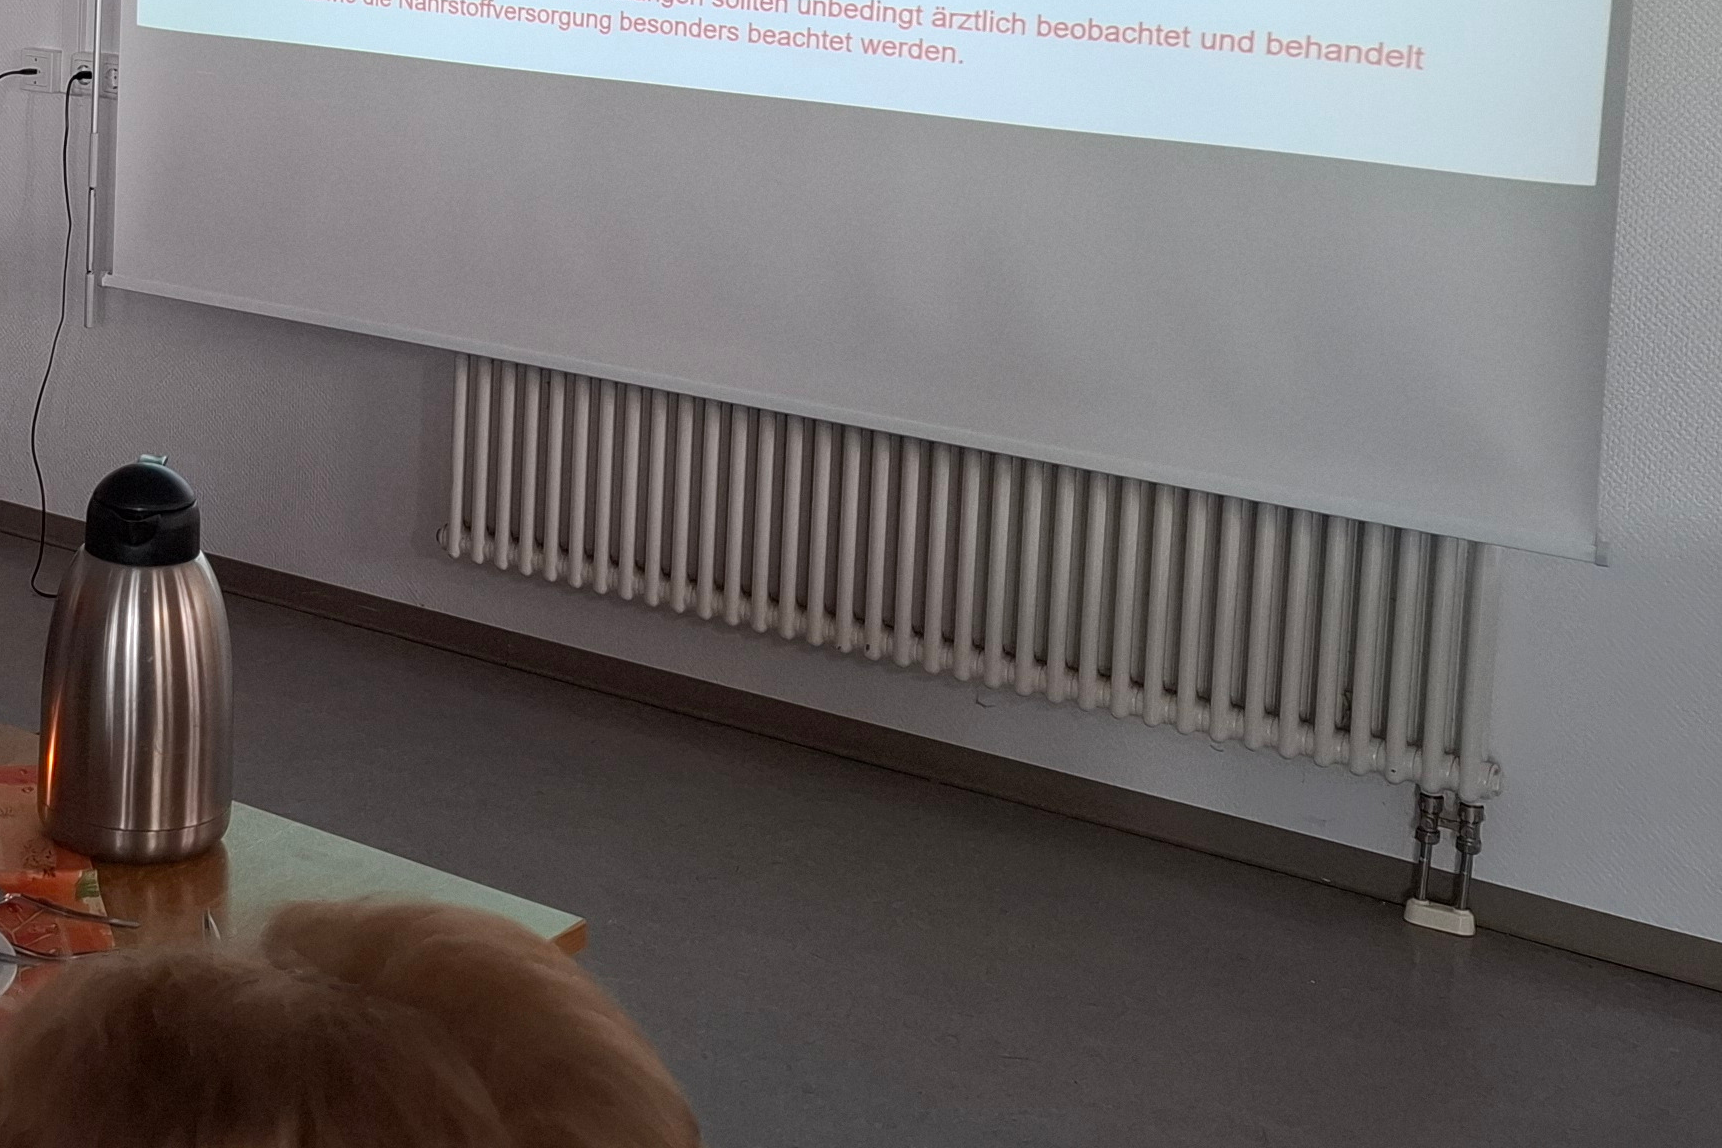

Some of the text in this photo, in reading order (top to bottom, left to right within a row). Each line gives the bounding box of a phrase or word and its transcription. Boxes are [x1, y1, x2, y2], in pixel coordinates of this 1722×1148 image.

[619, 11, 740, 42] besonders
[747, 23, 853, 53] beachtet
[860, 35, 964, 64] werden.
[931, 5, 1026, 36] ärztlich
[1036, 13, 1192, 49] beobachtet
[1200, 27, 1256, 54] und
[1265, 31, 1426, 71] behandelt
